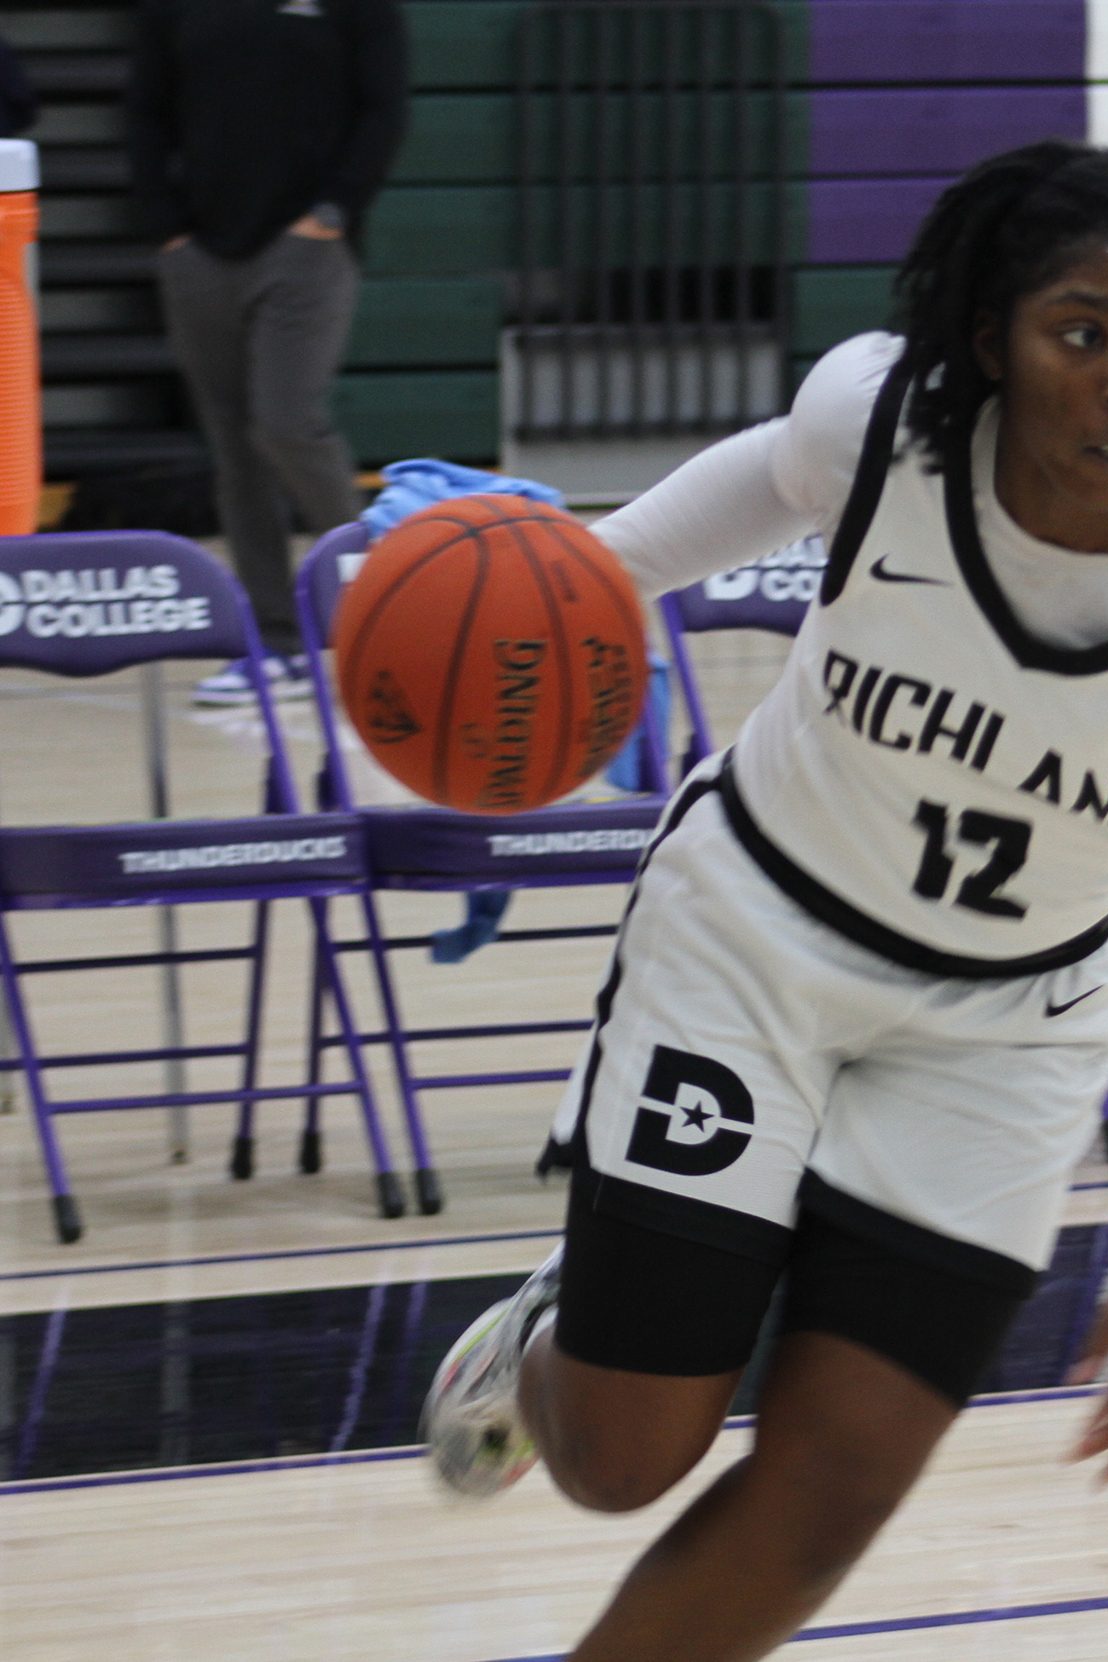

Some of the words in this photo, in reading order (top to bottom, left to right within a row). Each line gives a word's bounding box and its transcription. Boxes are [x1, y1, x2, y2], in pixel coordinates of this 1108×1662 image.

[20, 564, 181, 602] DALLAS
[26, 597, 212, 638] COLLEGE
[118, 836, 348, 874] THUNDERDUCKS
[486, 828, 655, 857] THUNDERD
[911, 796, 1034, 920] 12
